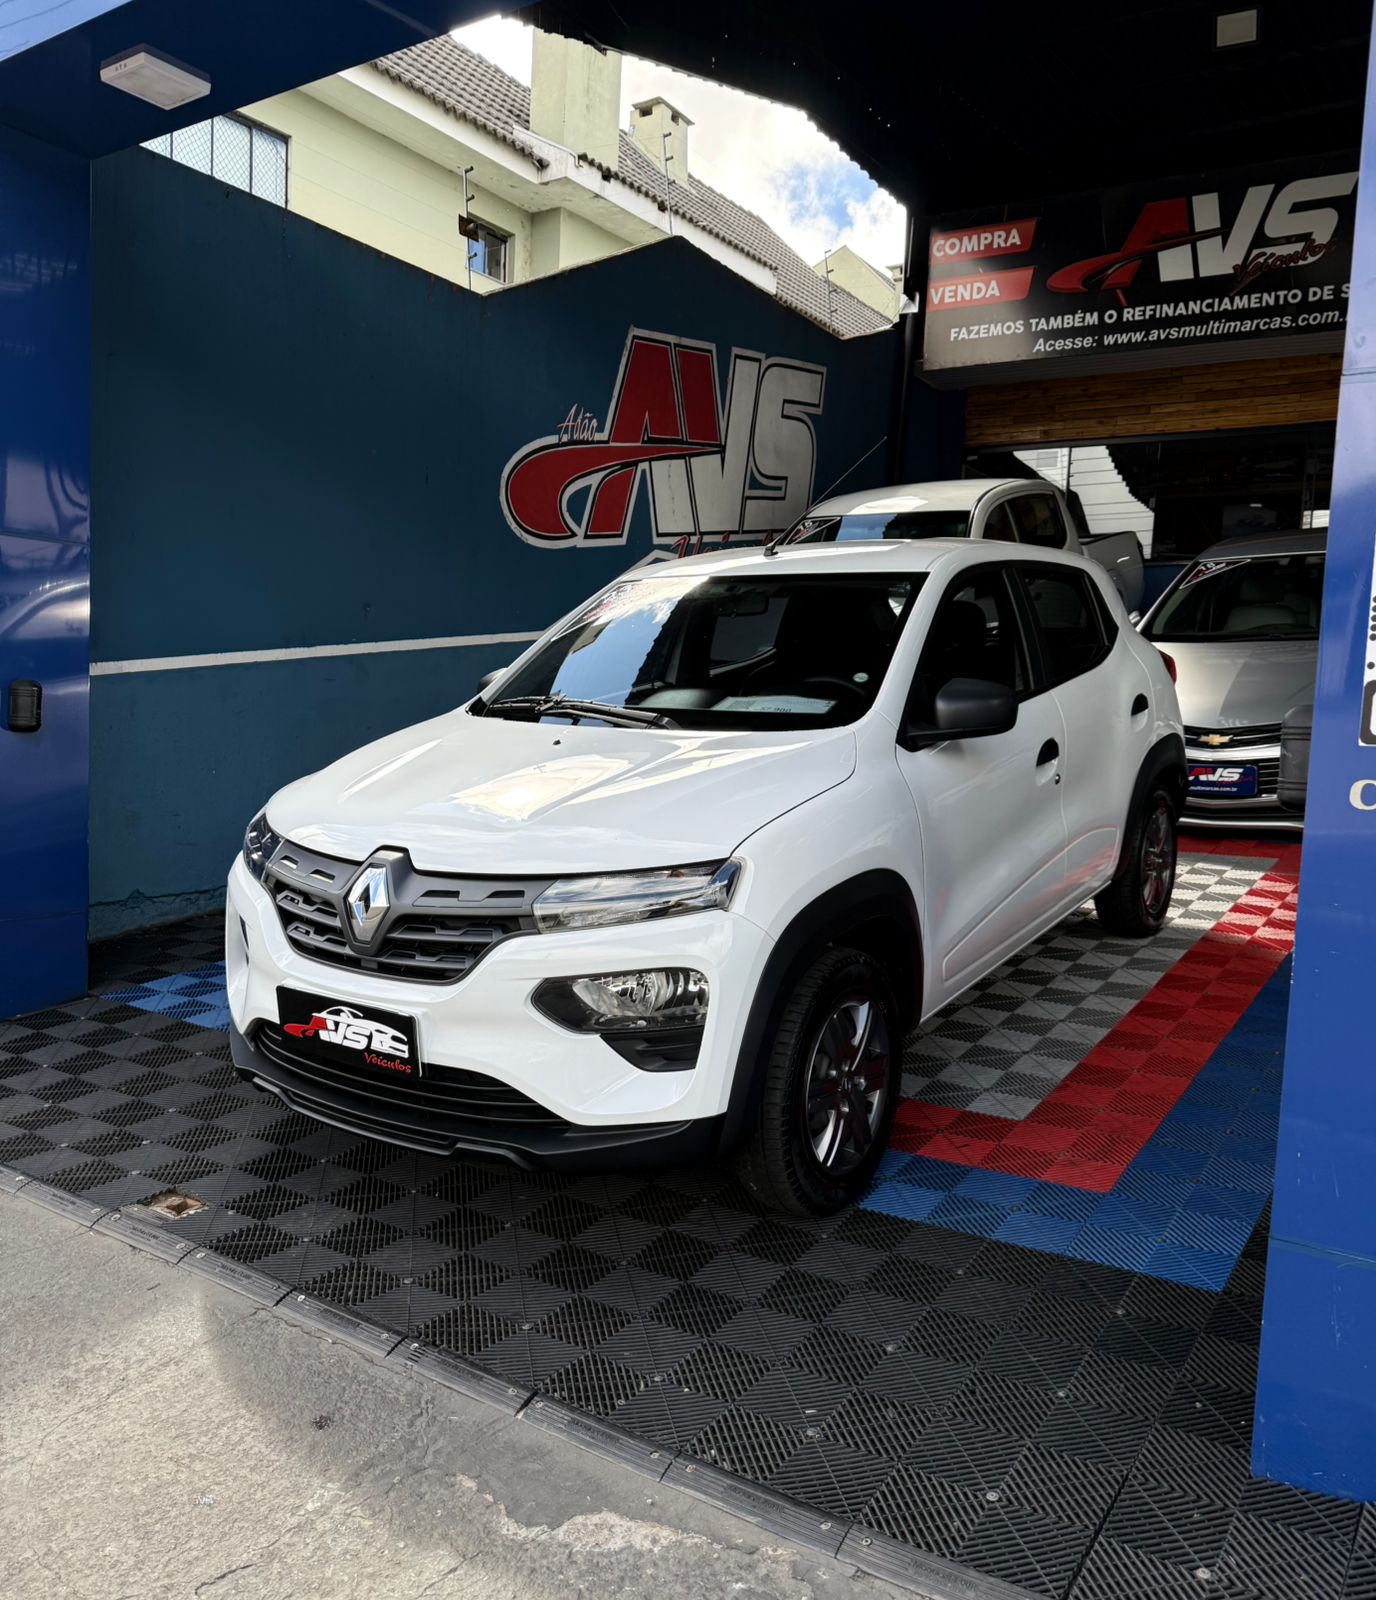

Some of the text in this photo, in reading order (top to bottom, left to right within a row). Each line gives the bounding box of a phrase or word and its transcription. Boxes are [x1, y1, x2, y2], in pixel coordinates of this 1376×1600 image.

[932, 228, 1021, 257] COMPRA
[1046, 171, 1358, 293] AVS
[930, 280, 1000, 305] VENDA
[950, 283, 1351, 342] FAZEMOS TAMBÉM O REFINANCIAMENTO DE S
[1032, 310, 1347, 353] Acesse: www.avsmultimarcas.com.
[500, 325, 828, 549] AVS
[556, 403, 598, 444] Adão
[1187, 767, 1244, 781] AVS
[283, 1016, 371, 1050] AVS
[364, 1052, 412, 1074] Veículos
